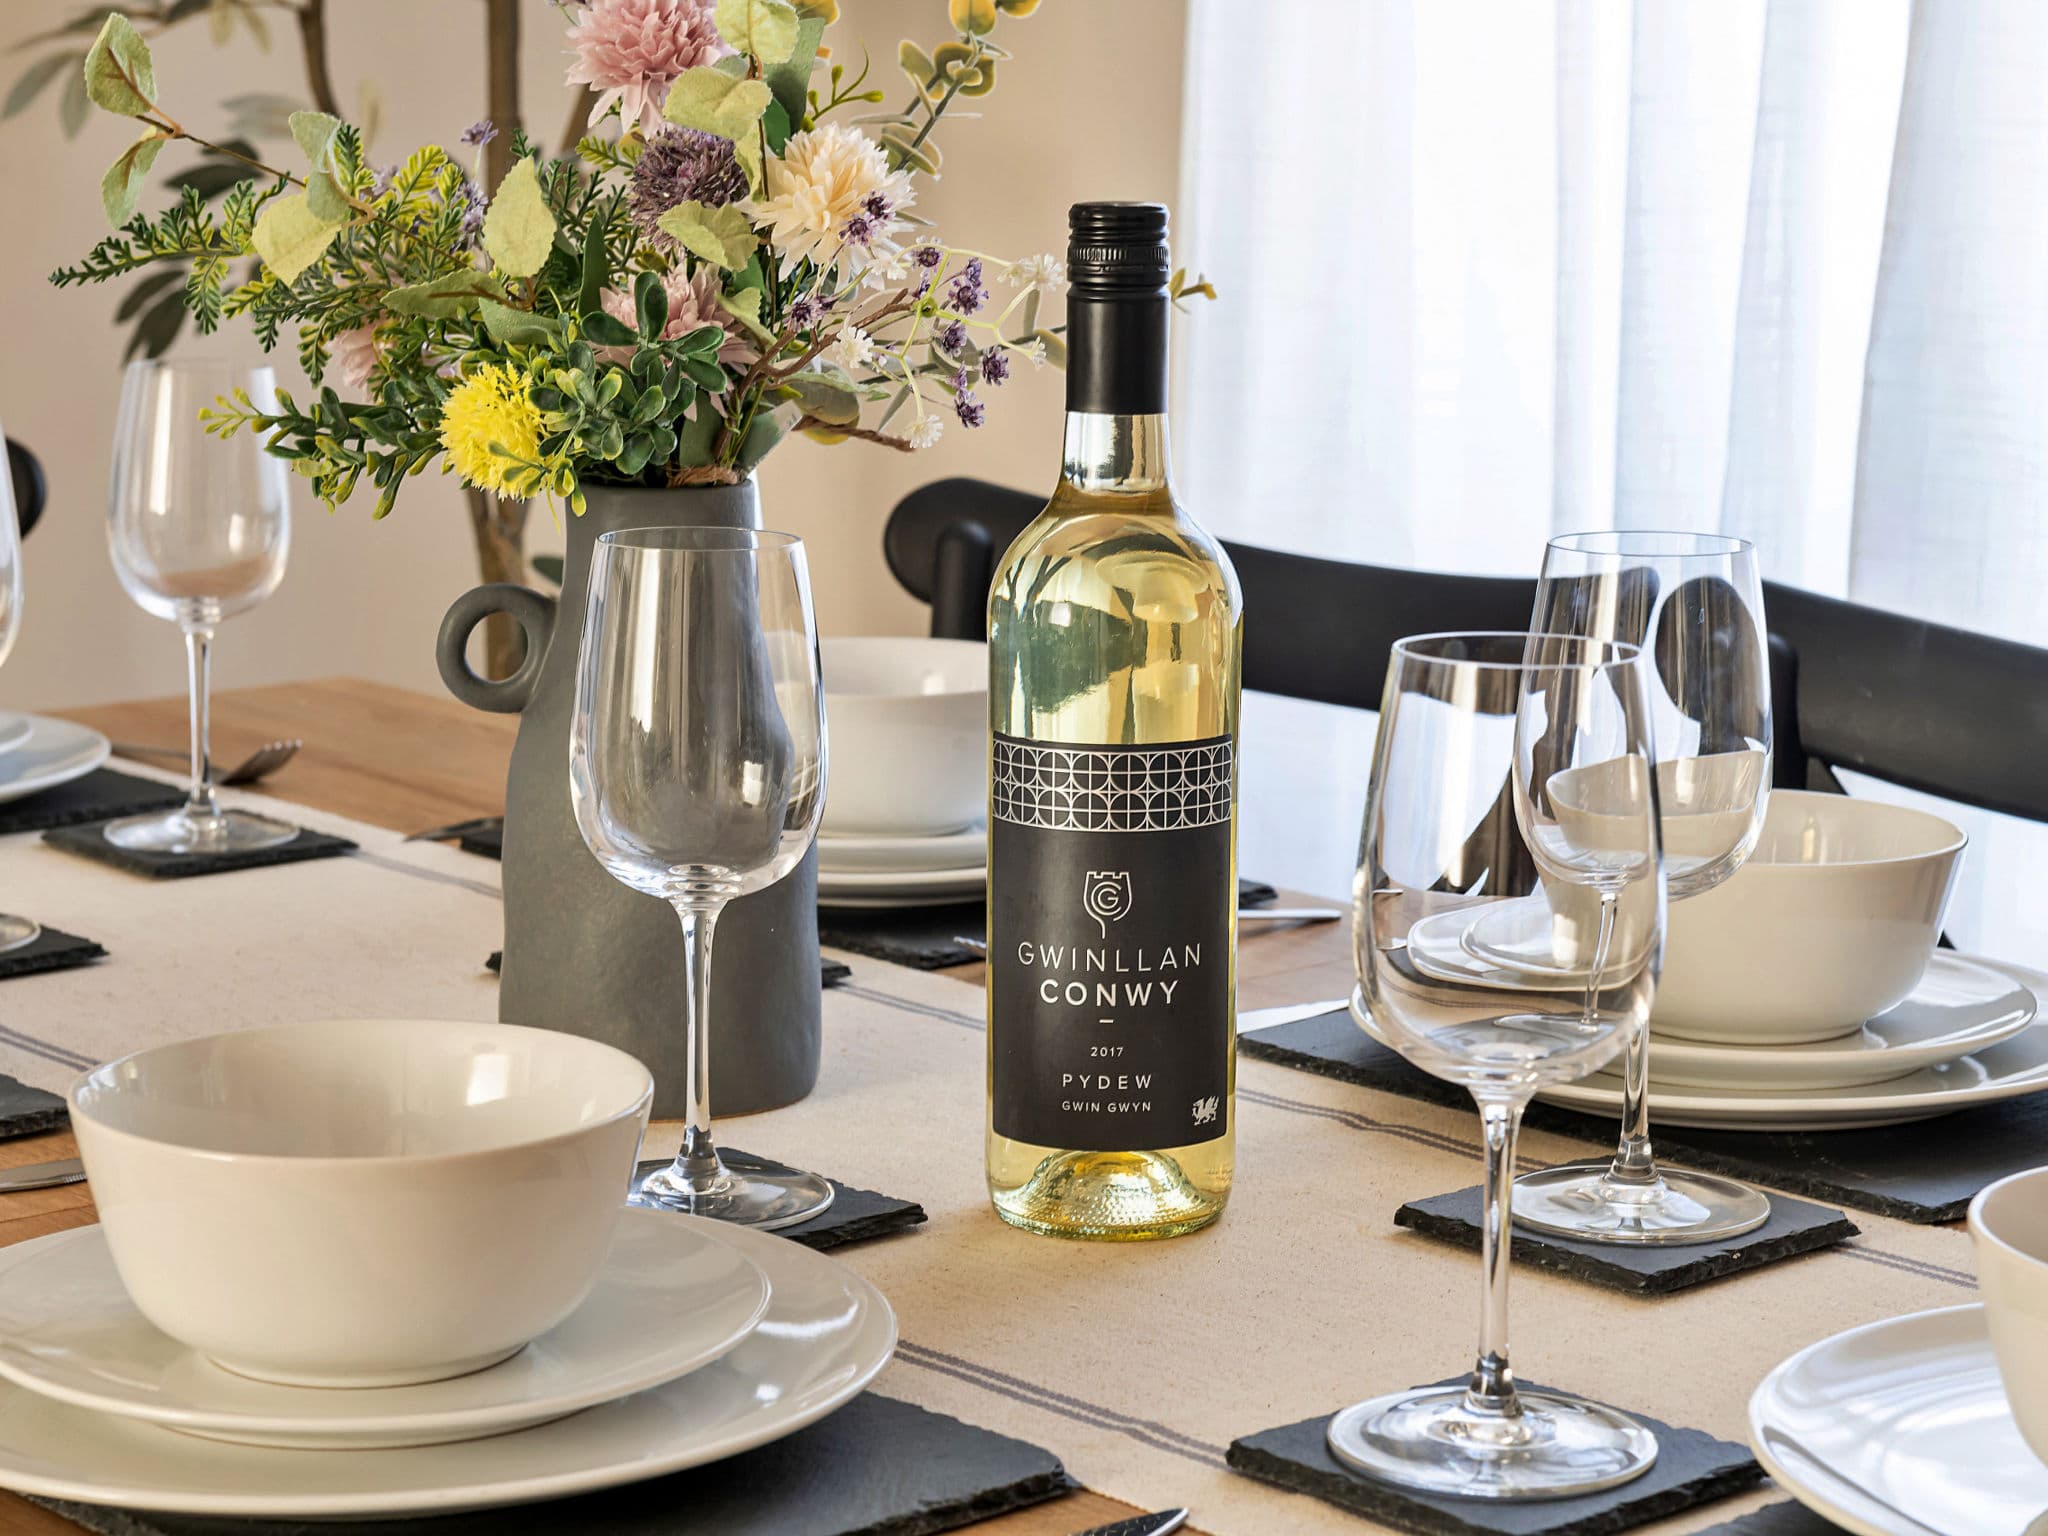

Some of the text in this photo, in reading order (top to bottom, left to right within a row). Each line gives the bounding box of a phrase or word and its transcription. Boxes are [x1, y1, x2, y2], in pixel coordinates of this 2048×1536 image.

[1018, 942, 1201, 972] GWINLLAN
[1040, 979, 1178, 1006] CONWY
[1090, 1046, 1124, 1057] 2017
[1062, 1074, 1152, 1089] PYDEW
[1062, 1101, 1152, 1113] GWIN GWYN
